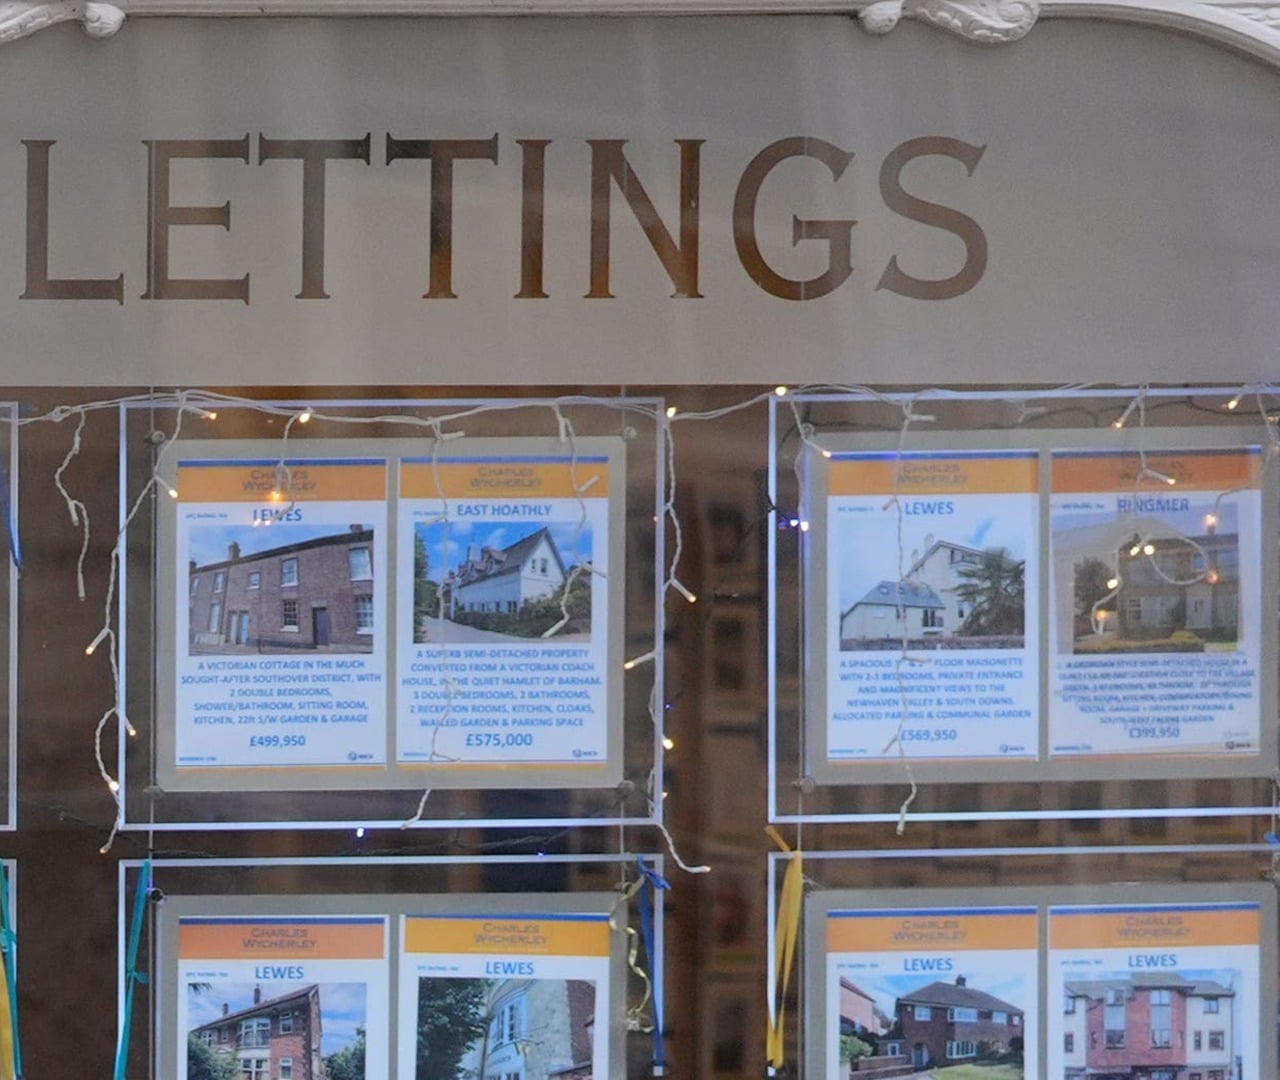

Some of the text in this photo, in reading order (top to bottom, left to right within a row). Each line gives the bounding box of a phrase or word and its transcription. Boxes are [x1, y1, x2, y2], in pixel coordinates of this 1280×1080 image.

[19, 132, 989, 305] LETTINGS
[456, 504, 552, 516] EAST HOATHLY
[904, 502, 954, 515] LEWES
[1118, 499, 1190, 512] RINGMER
[250, 735, 306, 748] £499,950
[466, 733, 533, 748] £575,000
[904, 958, 953, 972] LEWES
[1128, 954, 1178, 968] LEWES
[256, 966, 304, 979] LEWES
[486, 962, 534, 975] LEWES
